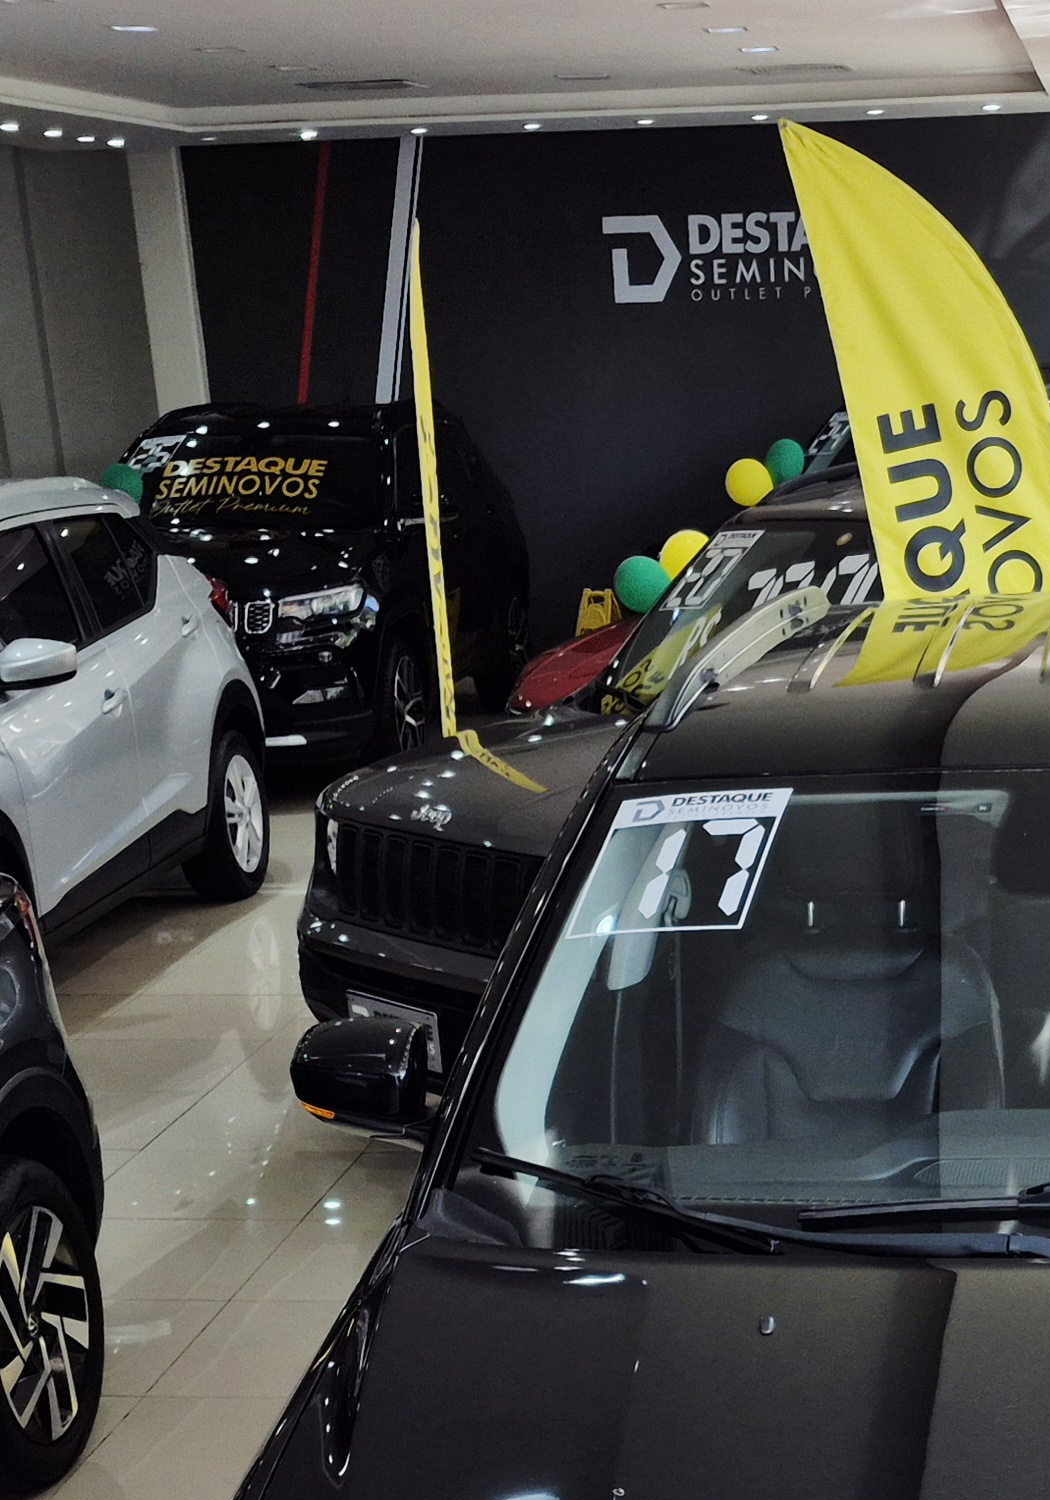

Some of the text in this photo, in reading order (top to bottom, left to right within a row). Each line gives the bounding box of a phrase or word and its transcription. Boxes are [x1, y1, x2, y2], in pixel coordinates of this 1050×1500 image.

[689, 257, 817, 286] SEMIN
[690, 286, 783, 302] OUTLET
[162, 457, 328, 477] DESTAQUE
[155, 475, 321, 499] SEMINOVOS
[877, 403, 969, 594] QUE
[668, 803, 768, 814] SEMINOVOS
[672, 792, 773, 807] DESTAQUE
[638, 818, 766, 920] 17
